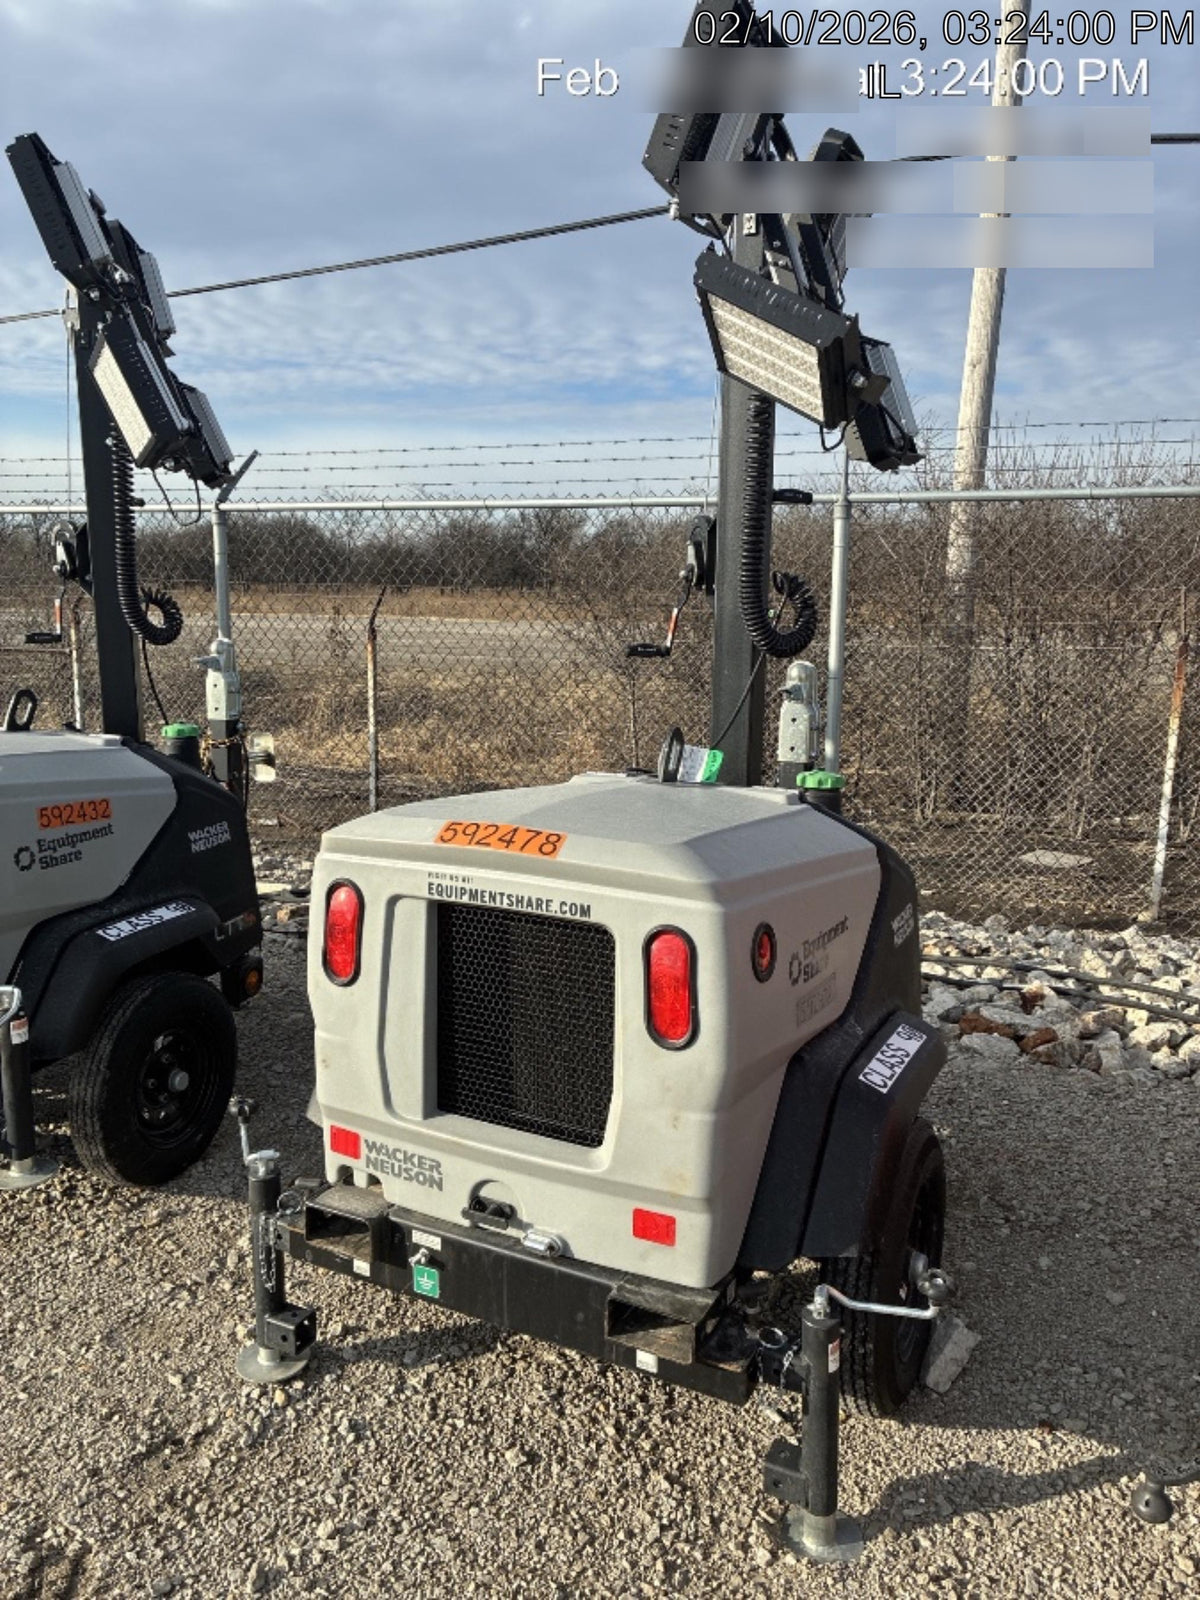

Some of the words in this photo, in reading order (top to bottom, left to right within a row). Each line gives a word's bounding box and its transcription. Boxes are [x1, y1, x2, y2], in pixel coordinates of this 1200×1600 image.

[39, 798, 111, 829] 592432
[36, 822, 115, 854] Equipment
[440, 821, 562, 856] 592478
[38, 848, 83, 870] Share
[427, 882, 592, 919] EQUIPMENTSHARE.COM
[861, 1042, 911, 1089] CLASS
[364, 1138, 444, 1175] WACKER
[365, 1154, 444, 1192] NEUSON
